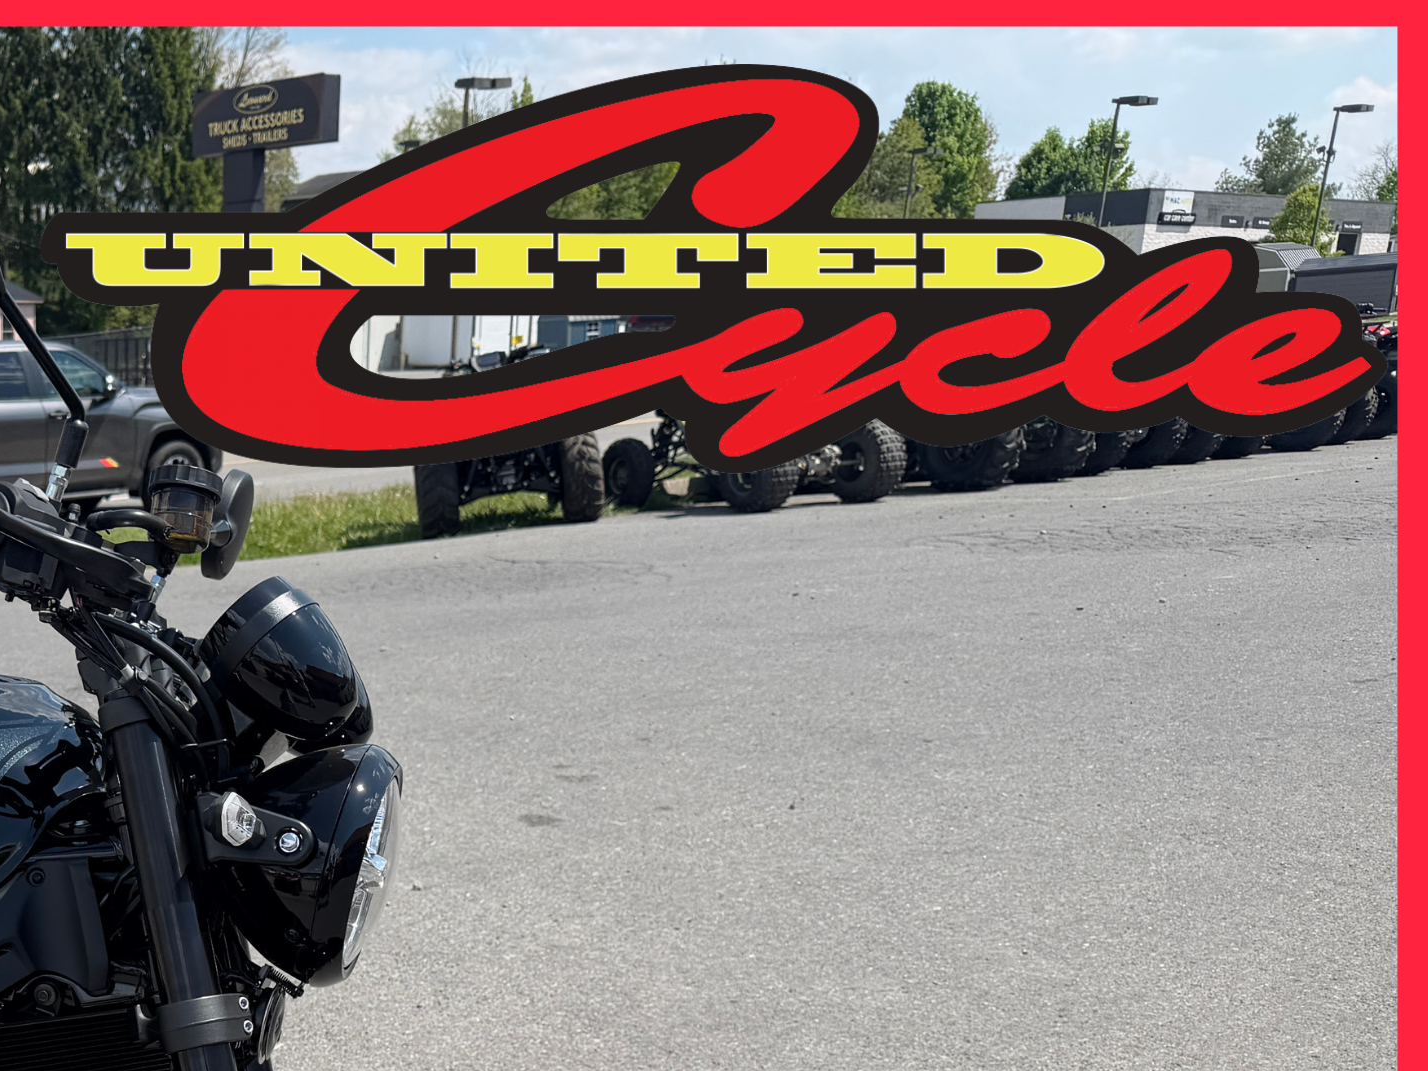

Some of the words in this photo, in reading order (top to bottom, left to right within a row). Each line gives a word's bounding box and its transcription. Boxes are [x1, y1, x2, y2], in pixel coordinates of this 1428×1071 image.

[208, 118, 239, 137] TRUCK
[240, 108, 305, 132] ACCESSORIES
[252, 127, 288, 144] TRAILERS
